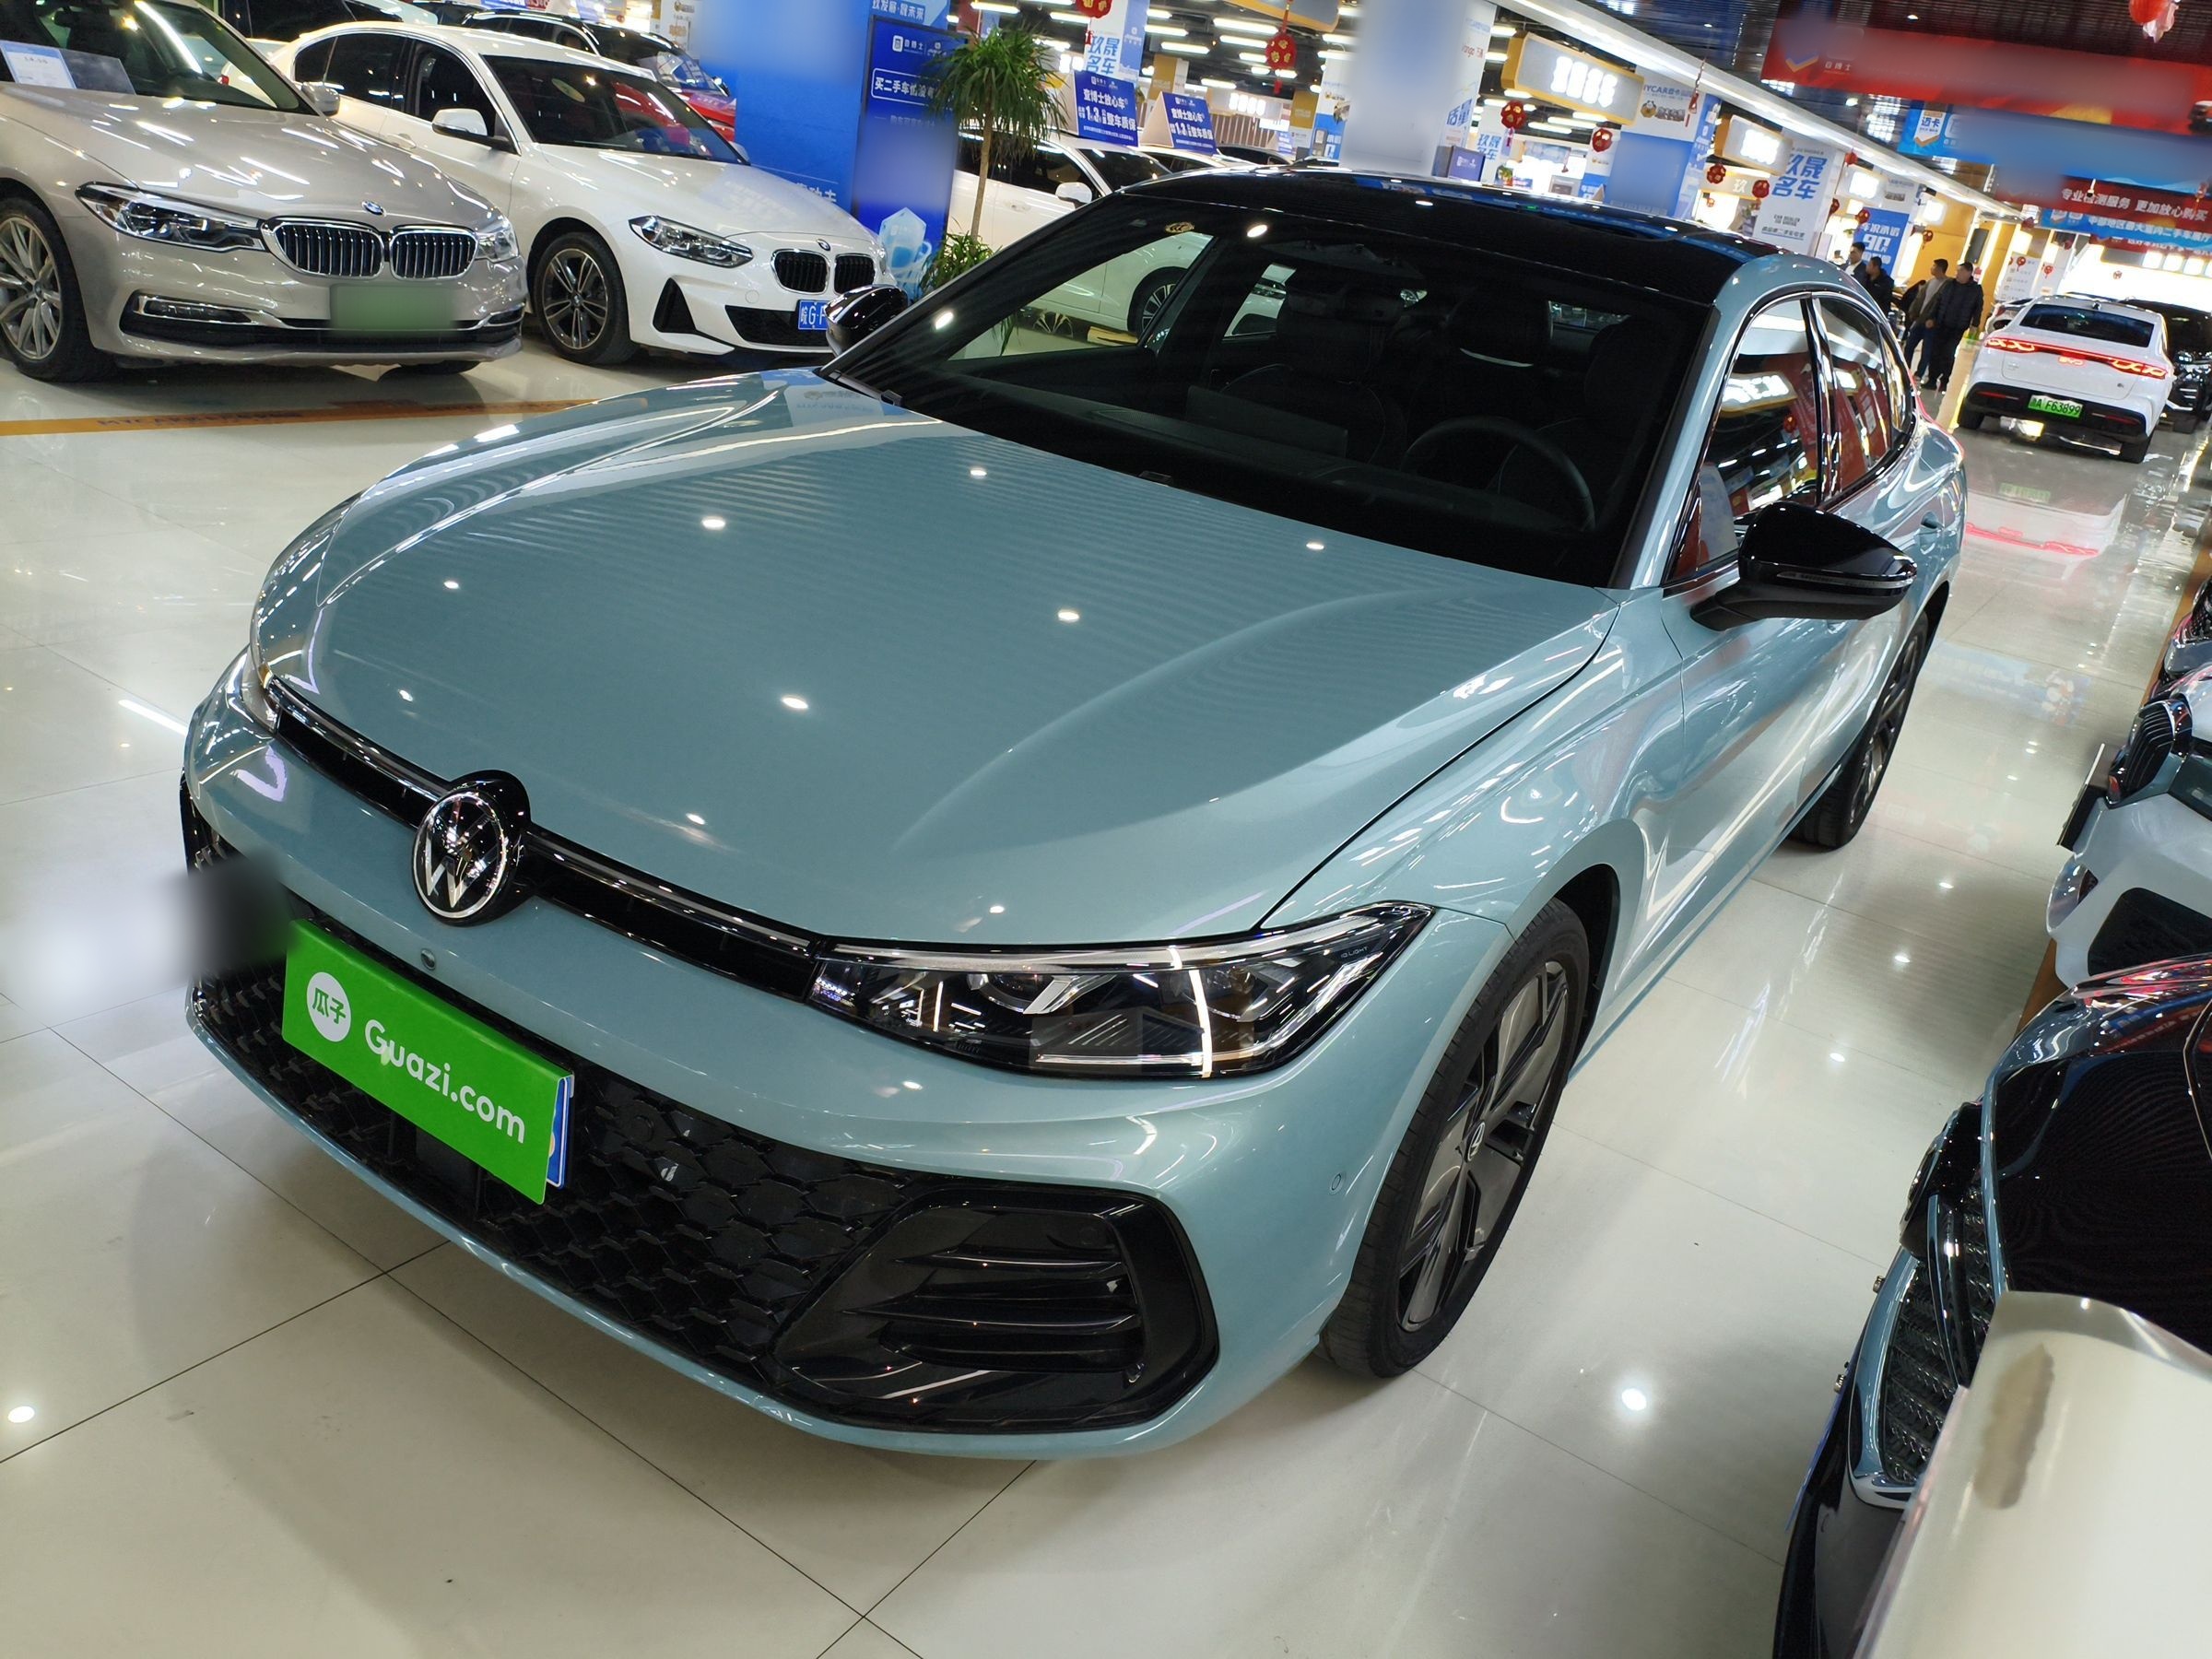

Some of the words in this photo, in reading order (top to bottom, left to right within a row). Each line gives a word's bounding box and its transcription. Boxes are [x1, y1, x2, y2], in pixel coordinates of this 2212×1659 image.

[1771, 175, 1820, 199] 名车
[2061, 187, 2131, 210] 专业检测服务
[2135, 199, 2209, 222] 更加放心购买
[312, 987, 347, 1025] 瓜子
[364, 1018, 525, 1144] Guazi.com
